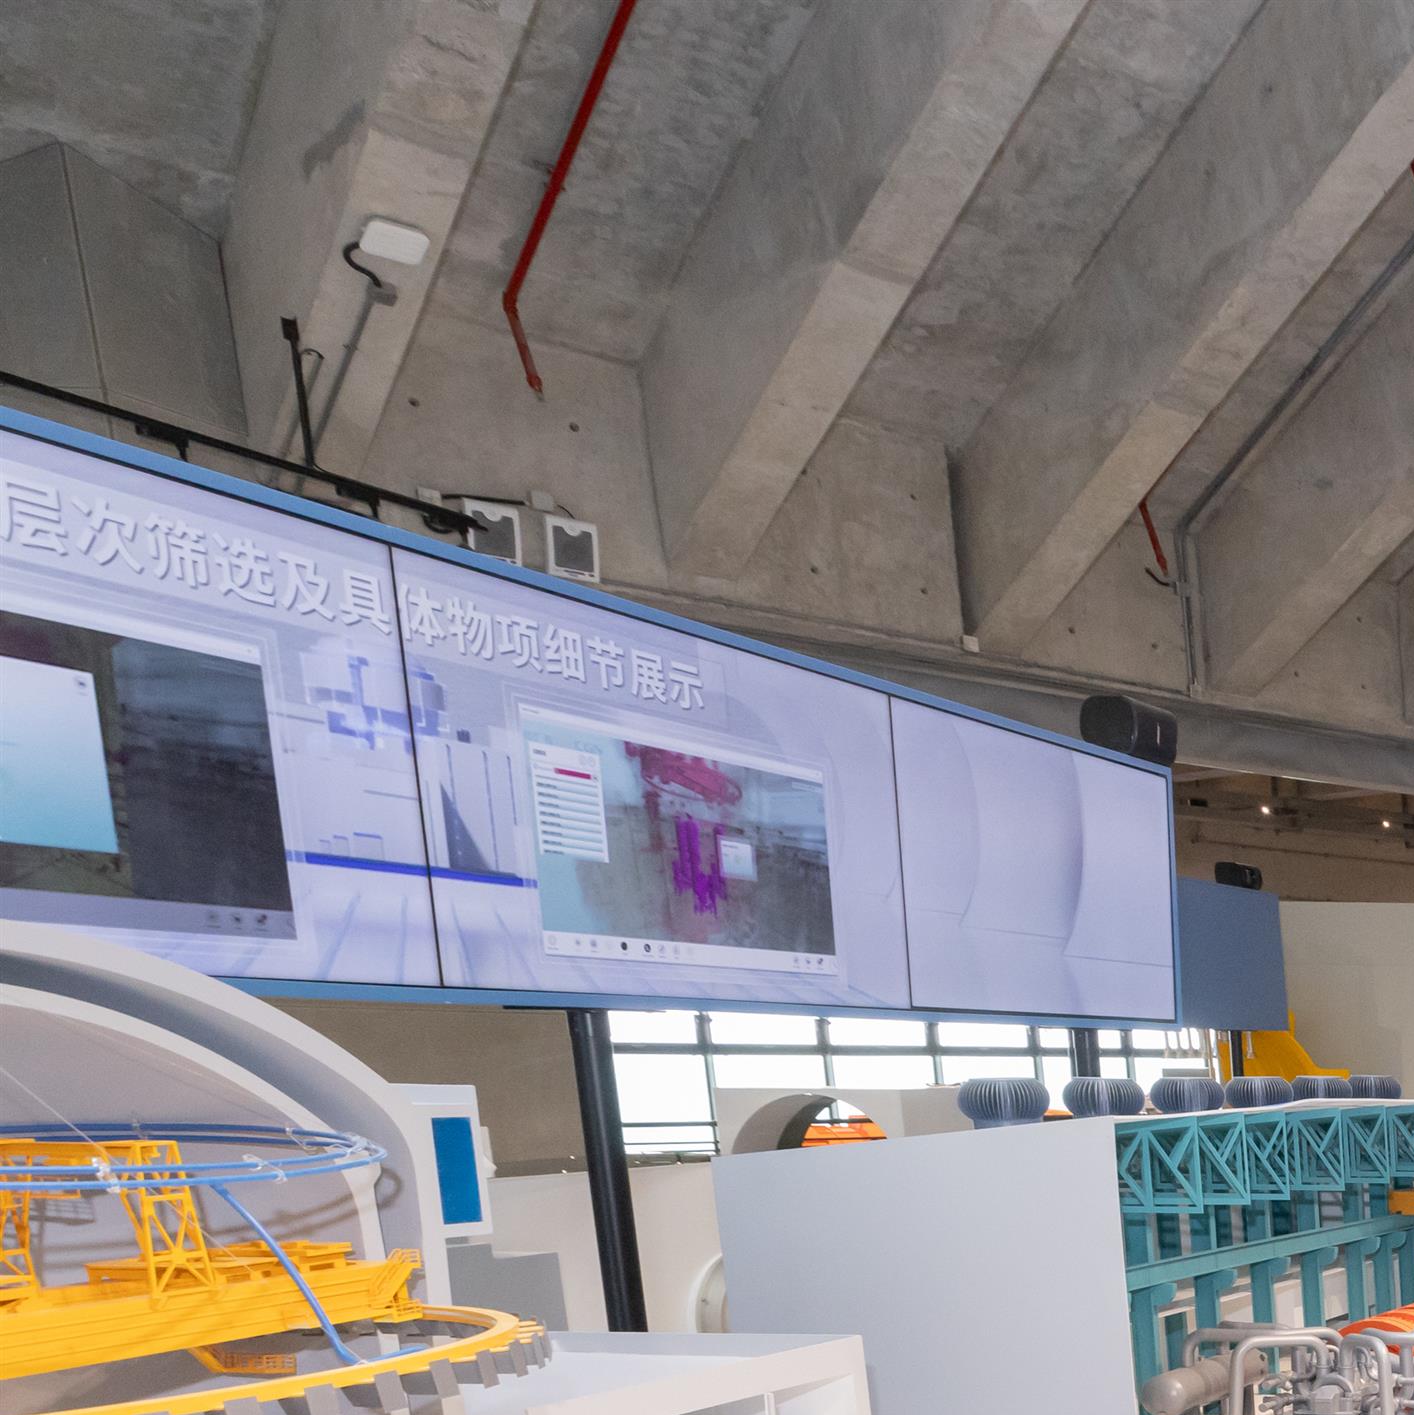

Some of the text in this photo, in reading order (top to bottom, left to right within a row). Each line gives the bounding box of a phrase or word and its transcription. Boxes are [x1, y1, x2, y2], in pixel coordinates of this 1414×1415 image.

[0, 479, 705, 711] 层次筛选及具体物项细节展示
